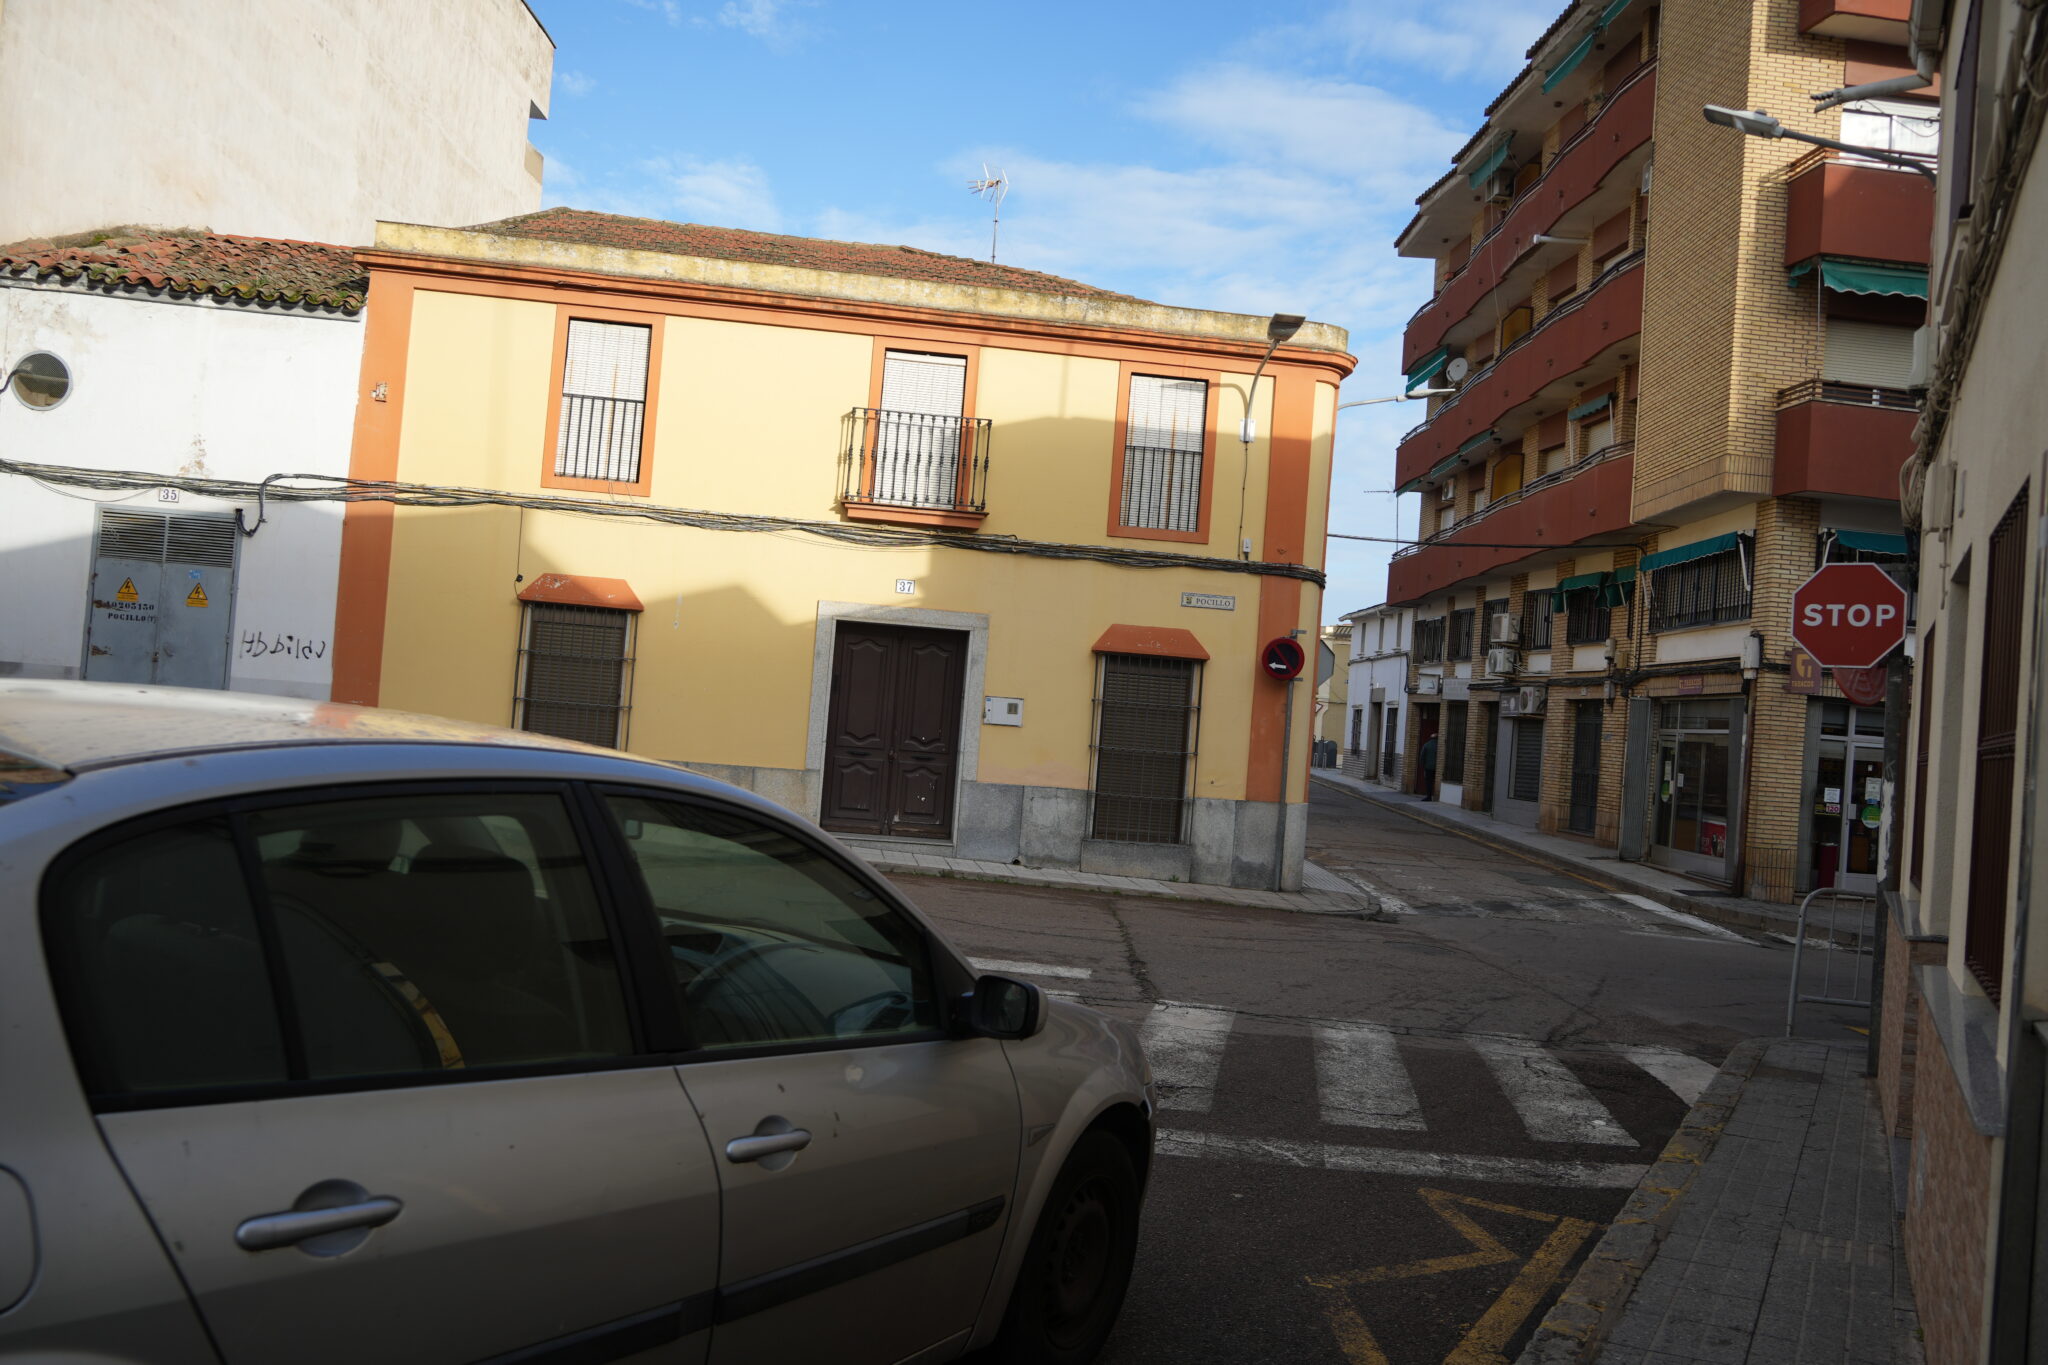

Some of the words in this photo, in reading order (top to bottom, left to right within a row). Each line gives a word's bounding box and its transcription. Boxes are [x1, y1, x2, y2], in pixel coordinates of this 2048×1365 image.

[163, 489, 177, 500] 35
[899, 581, 912, 593] 37
[1196, 597, 1231, 607] POCILLO
[1802, 603, 1896, 627] STOP
